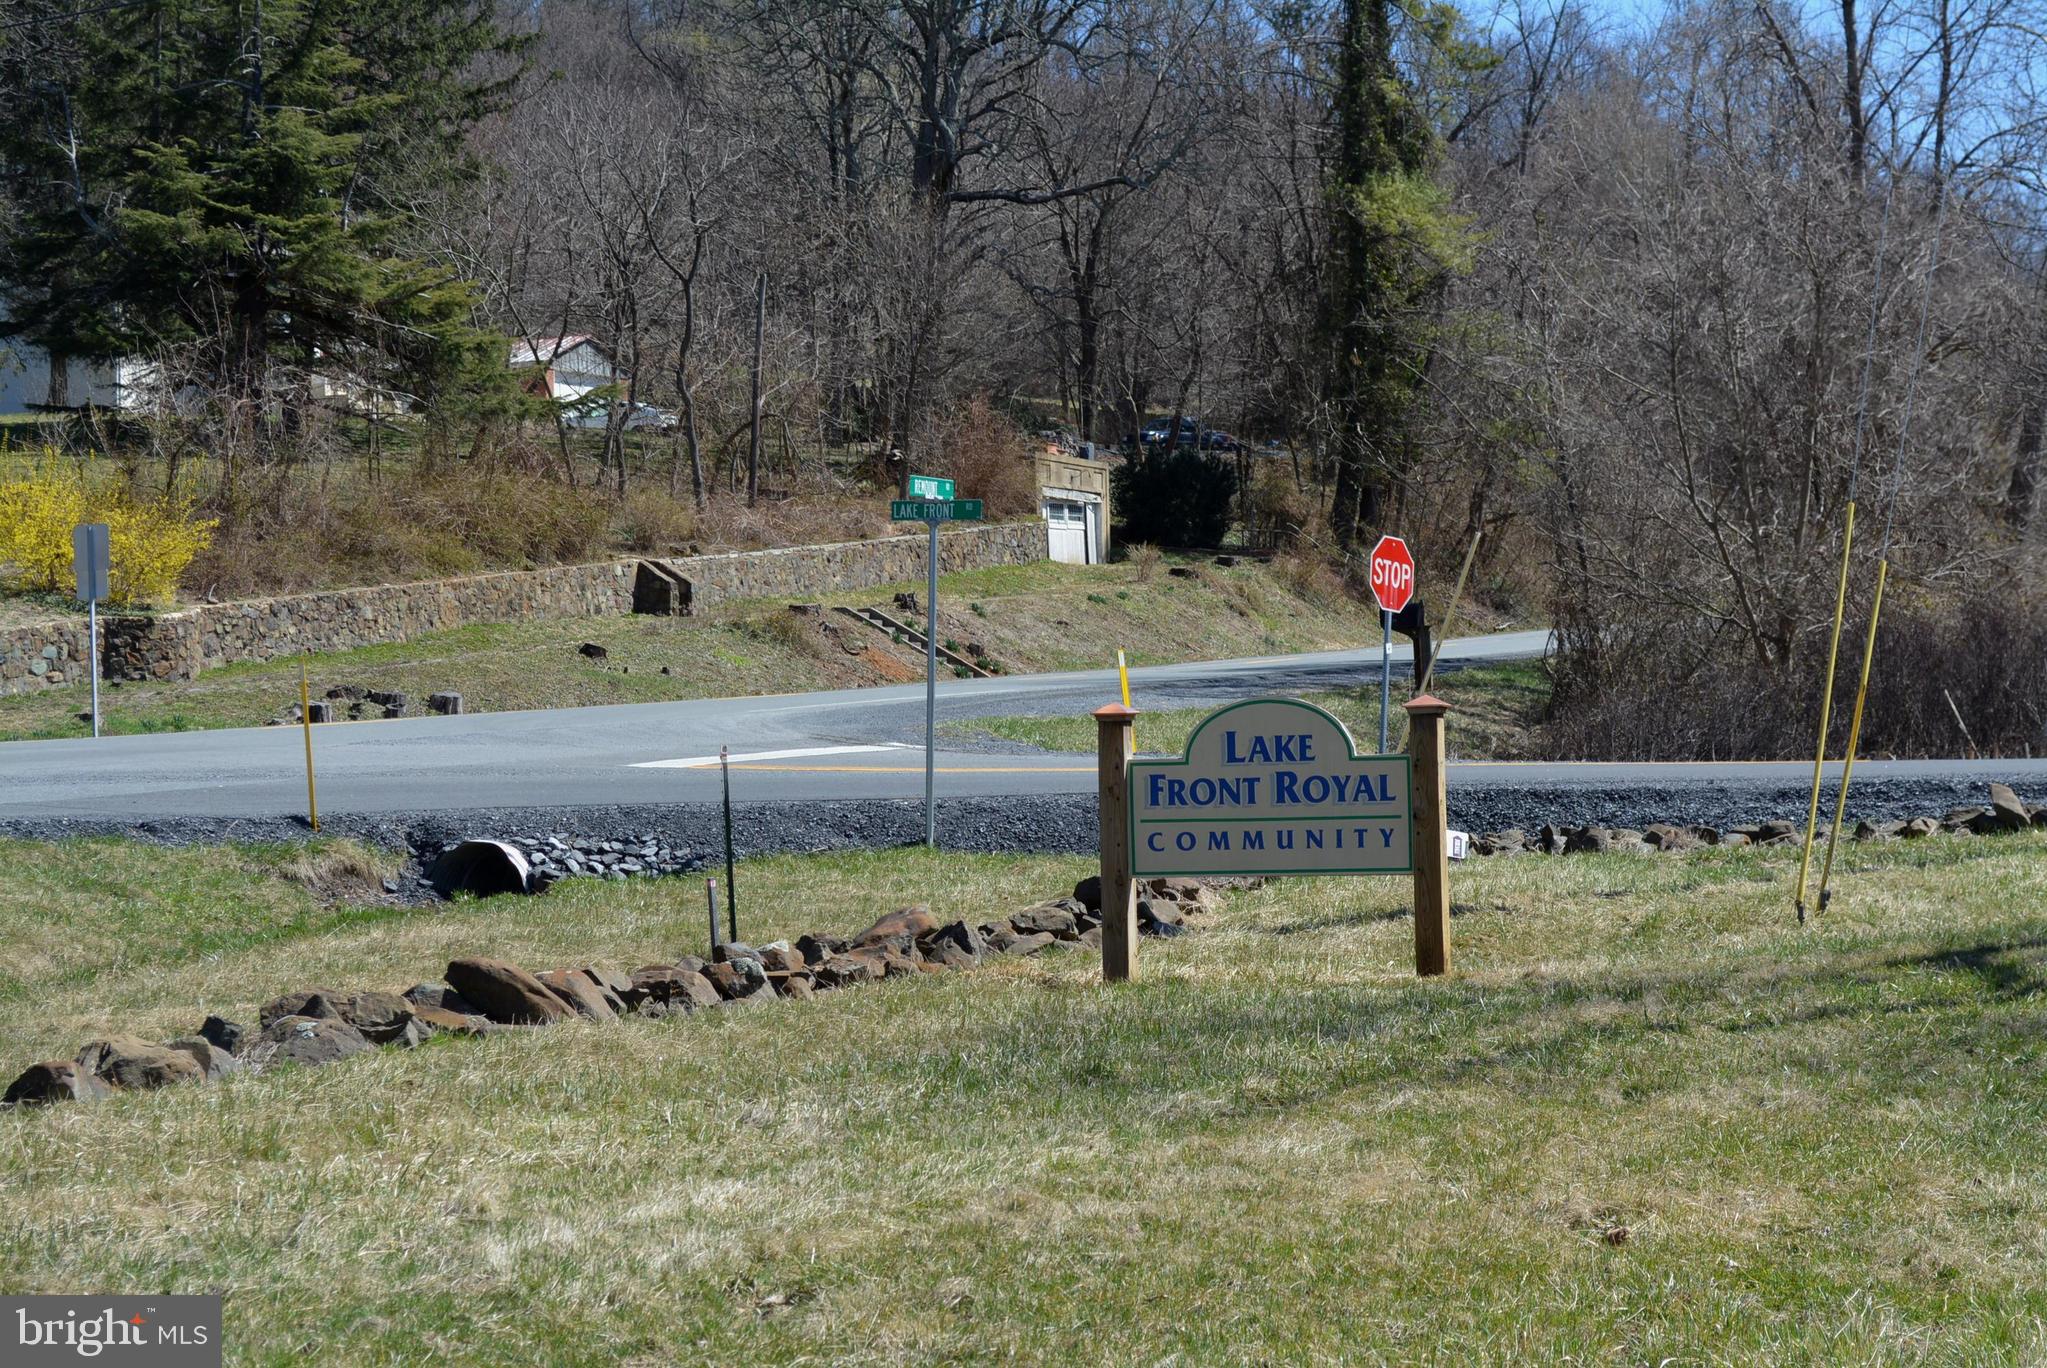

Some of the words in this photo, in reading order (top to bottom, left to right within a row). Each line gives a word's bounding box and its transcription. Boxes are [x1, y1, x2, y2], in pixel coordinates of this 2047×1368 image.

[893, 503, 919, 518] LAKE
[923, 503, 955, 518] FRONT
[965, 502, 973, 511] RD
[1373, 557, 1411, 590] STOP
[1223, 731, 1317, 766] LAKE
[1146, 773, 1261, 808] FRONT
[1273, 771, 1397, 805] ROYAL
[1147, 827, 1395, 852] COMMUNITY
